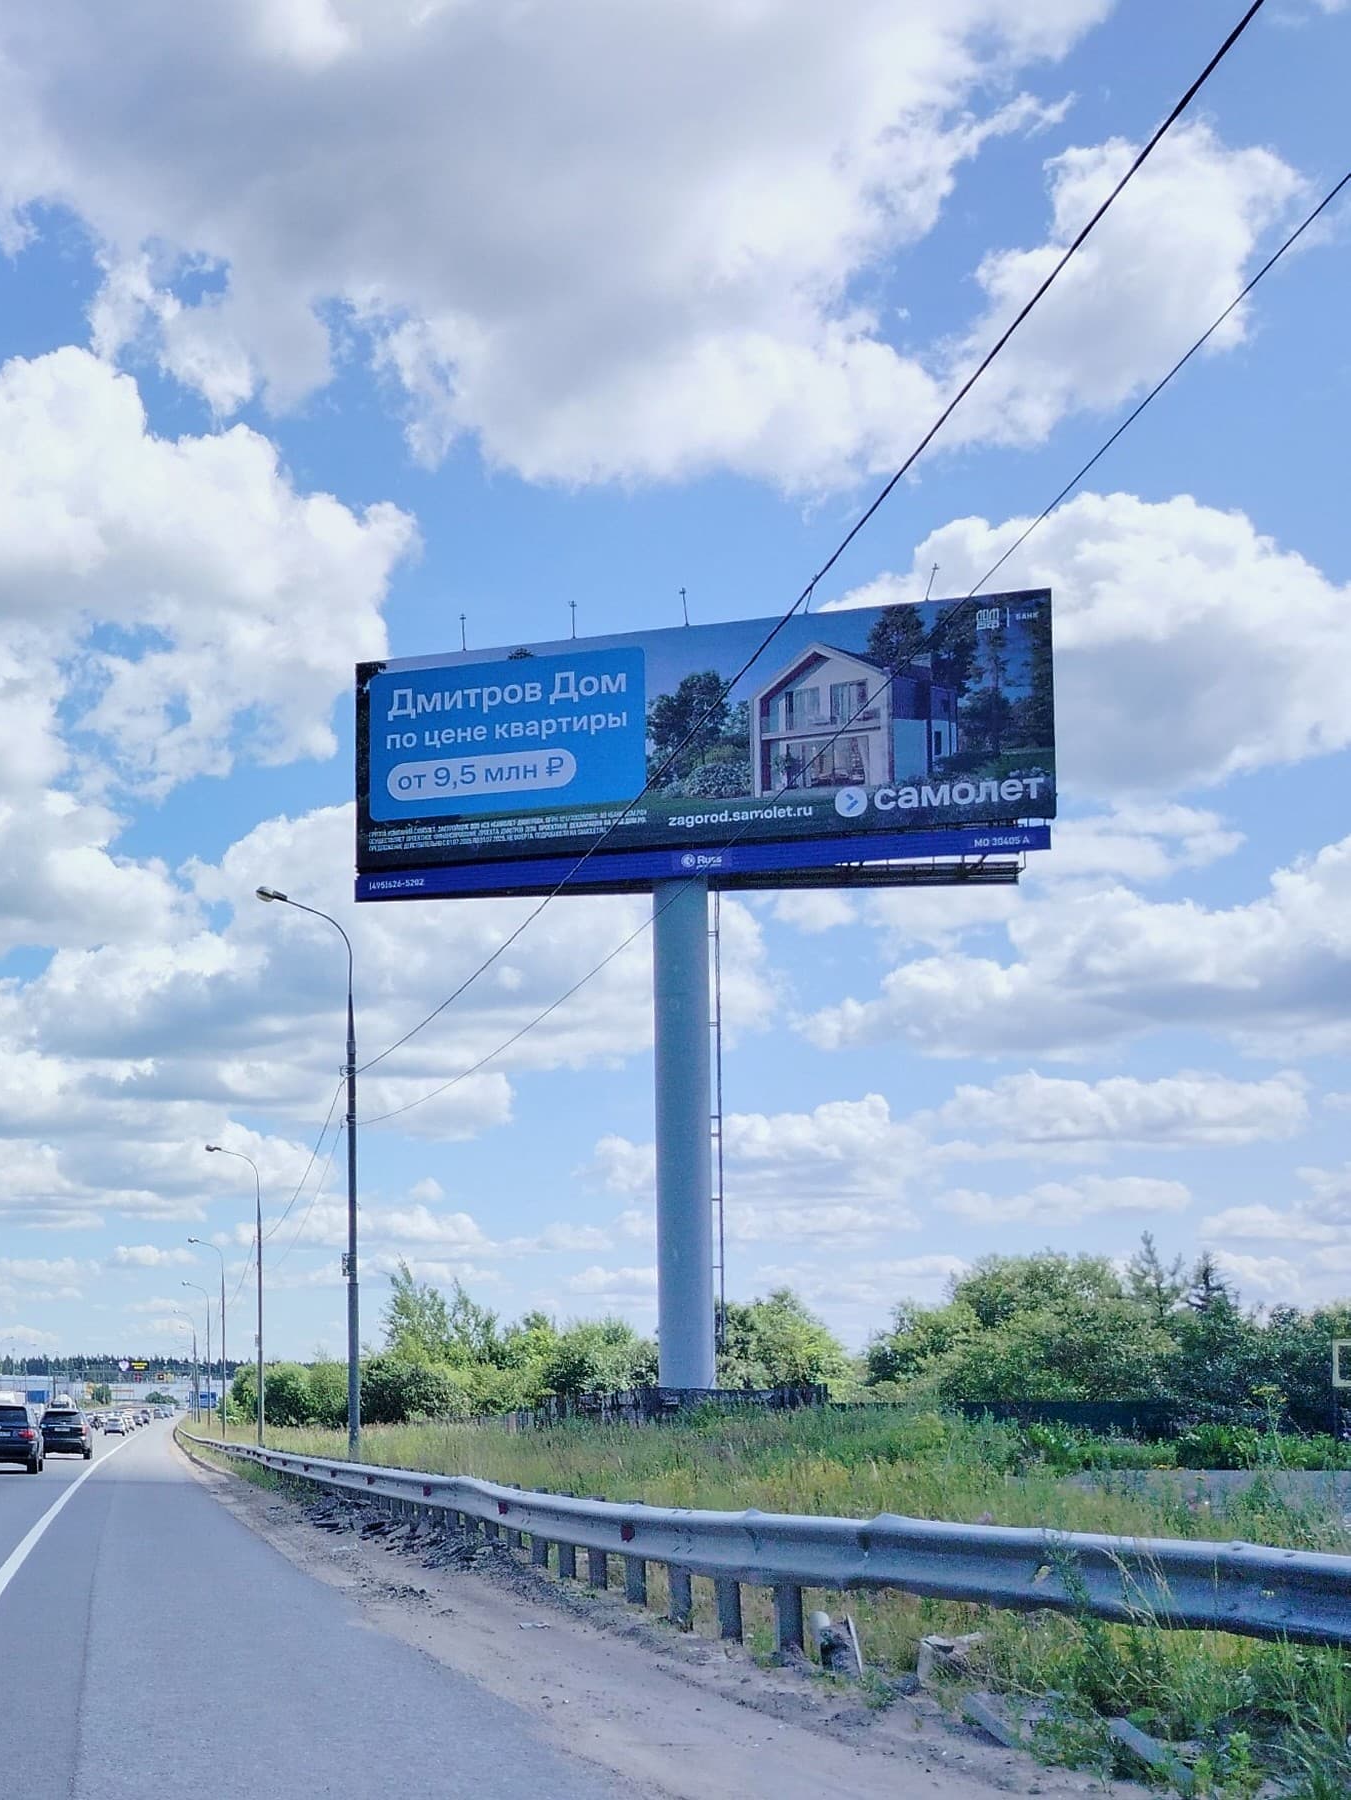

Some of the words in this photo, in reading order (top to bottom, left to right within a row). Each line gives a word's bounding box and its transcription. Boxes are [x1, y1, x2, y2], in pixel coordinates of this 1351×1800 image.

[388, 681, 541, 721] Дмитров
[549, 671, 626, 704] Дом
[386, 732, 417, 750] по
[424, 724, 488, 749] цене
[494, 711, 627, 740] квартиры
[397, 772, 427, 791] от
[433, 764, 477, 790] 9,5
[484, 762, 538, 784] млн
[874, 777, 1044, 810] самолет
[668, 805, 813, 827] zagorod.samolet.ru
